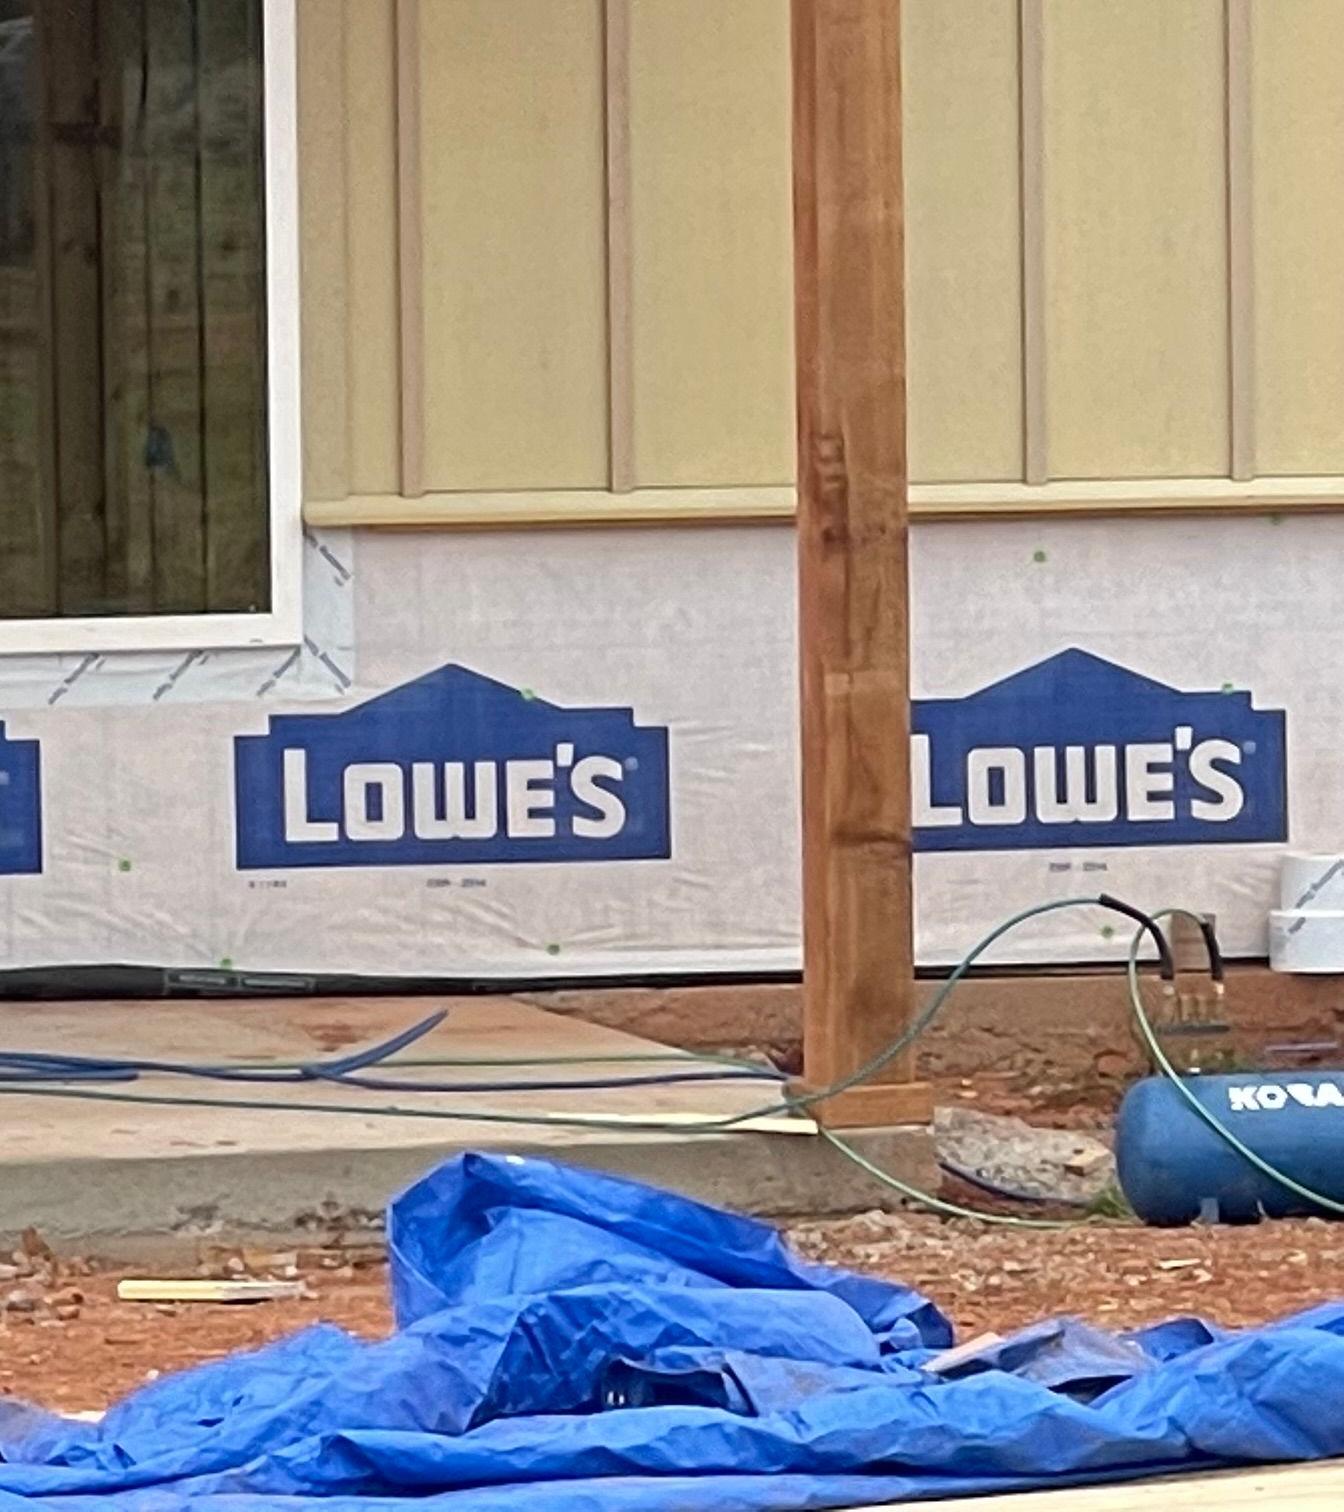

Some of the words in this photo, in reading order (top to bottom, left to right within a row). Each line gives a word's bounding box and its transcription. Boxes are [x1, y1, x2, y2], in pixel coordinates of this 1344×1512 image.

[282, 742, 627, 843] LOWE'S
[910, 726, 1245, 827] LOWE'S
[1228, 1083, 1344, 1110] KOBA
